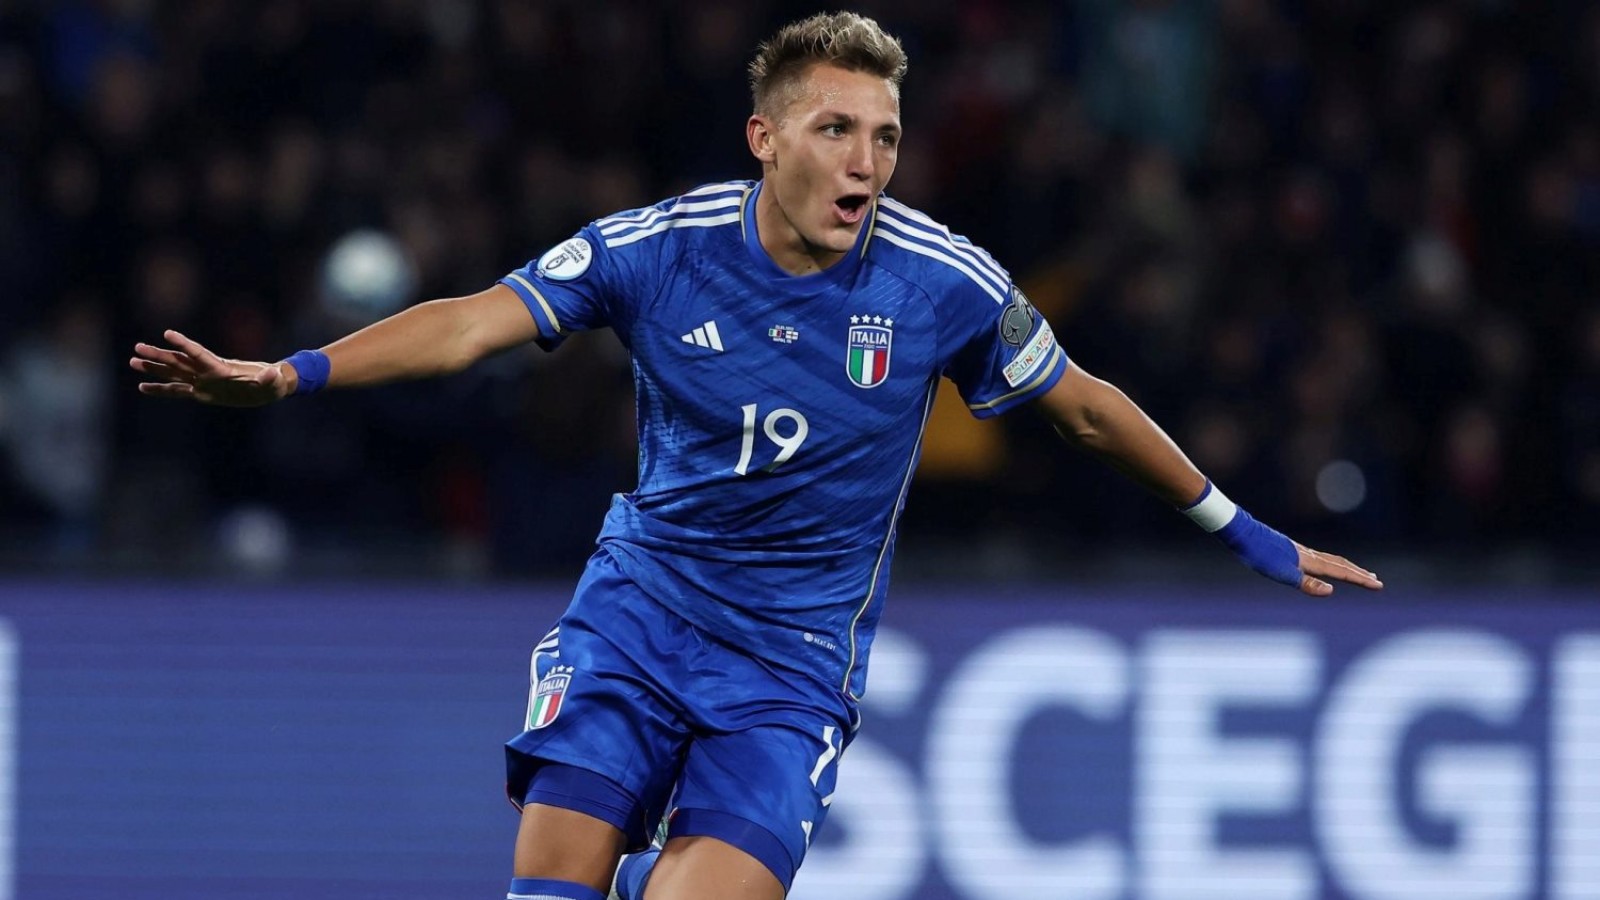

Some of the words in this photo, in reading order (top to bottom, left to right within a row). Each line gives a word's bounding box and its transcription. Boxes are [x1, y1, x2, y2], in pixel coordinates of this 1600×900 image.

[851, 331, 888, 345] ITALIA
[733, 403, 808, 476] 19
[538, 678, 566, 695] ITALIA
